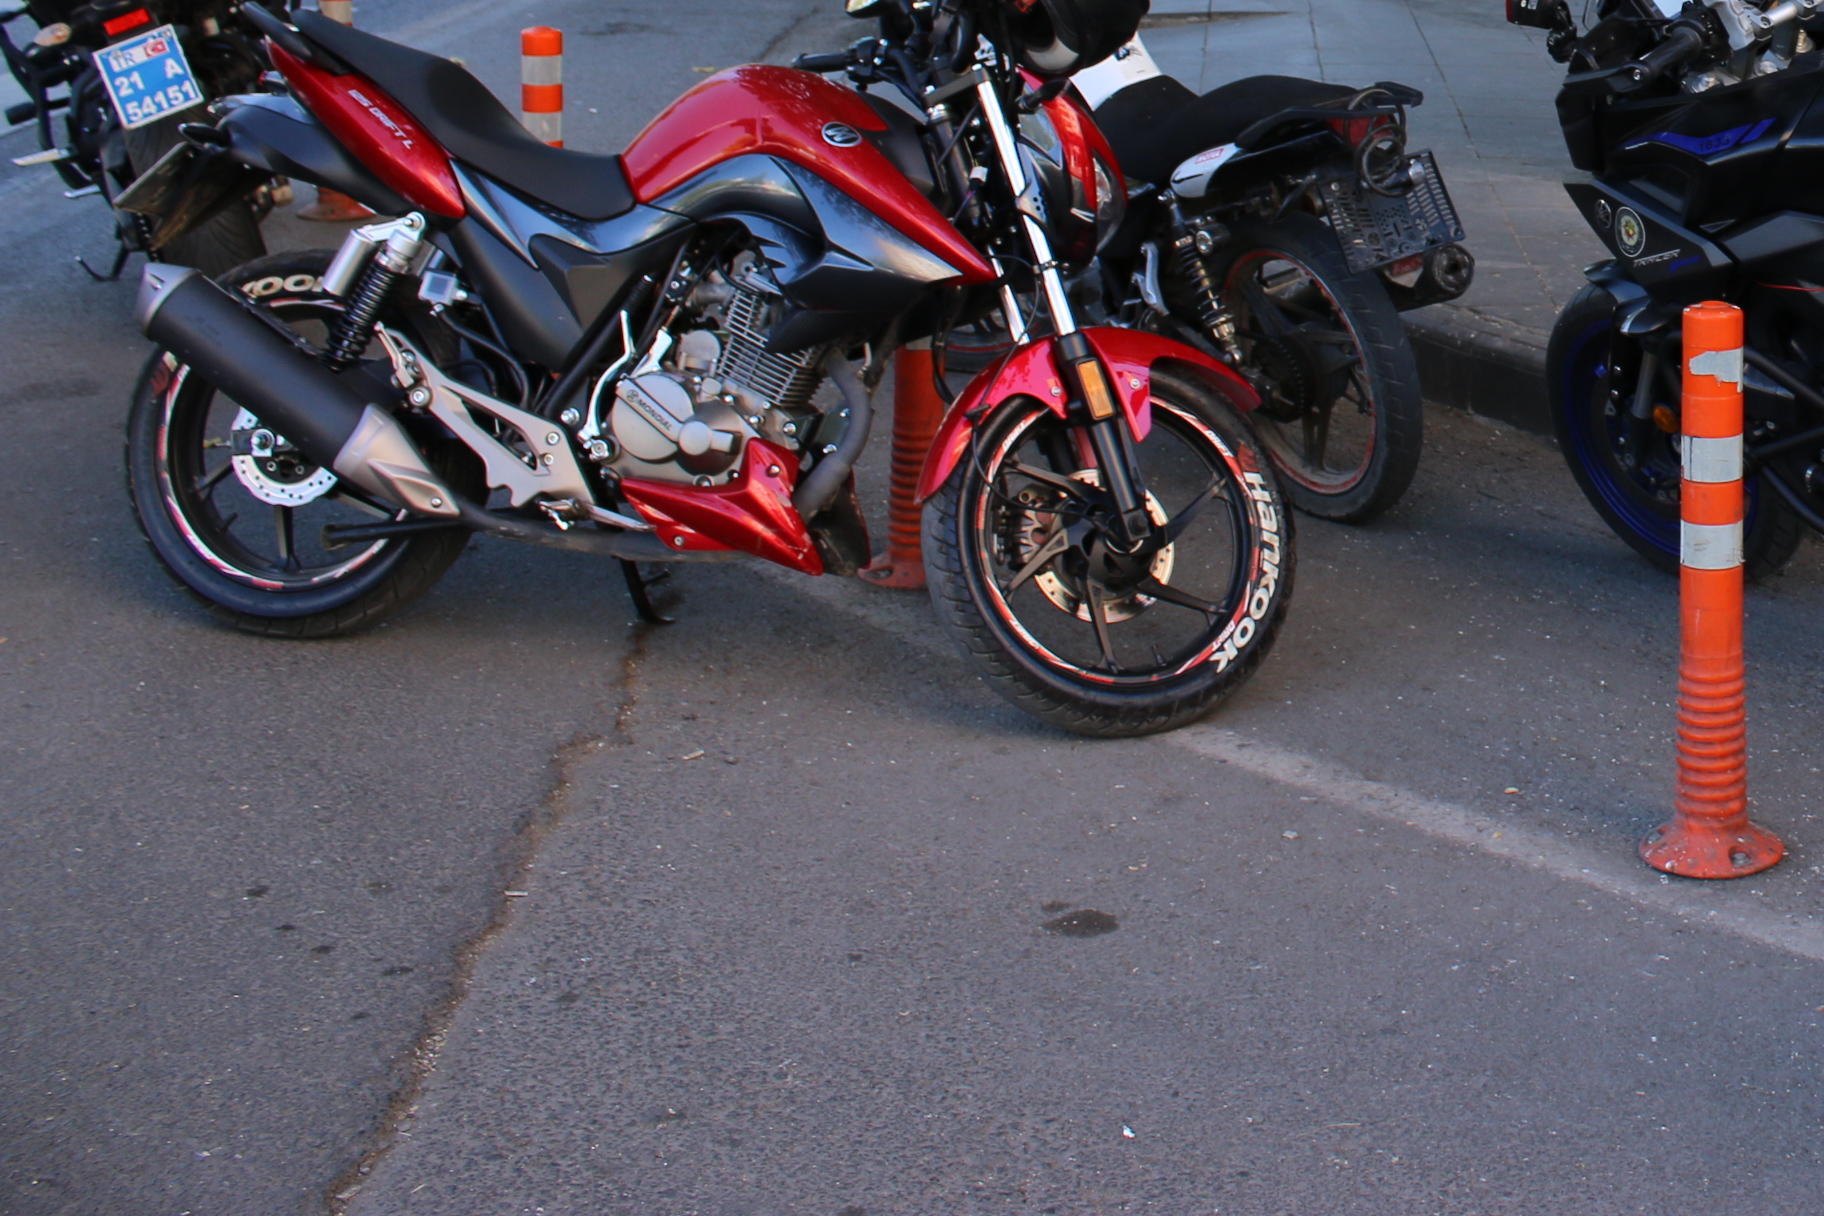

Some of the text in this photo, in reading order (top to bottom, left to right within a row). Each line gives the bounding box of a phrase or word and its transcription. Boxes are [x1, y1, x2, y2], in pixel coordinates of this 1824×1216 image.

[114, 57, 184, 98] 21 A
[125, 80, 196, 122] 54151
[637, 399, 672, 432] MONDIAL
